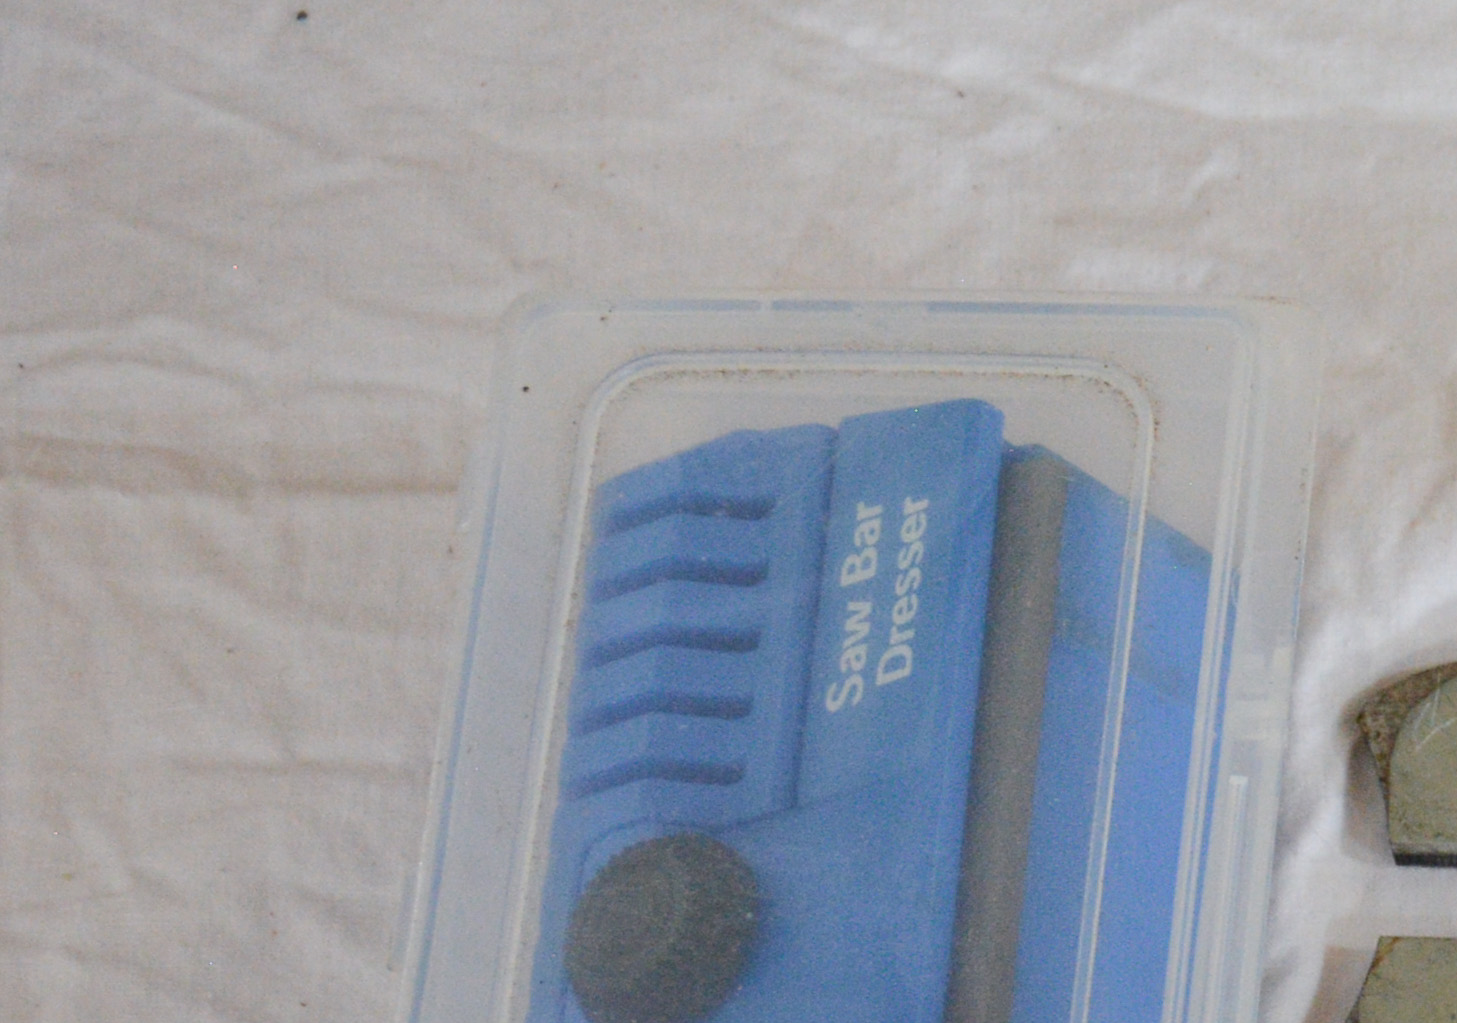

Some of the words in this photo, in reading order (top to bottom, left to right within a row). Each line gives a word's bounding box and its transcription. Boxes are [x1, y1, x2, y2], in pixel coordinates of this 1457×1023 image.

[840, 501, 882, 587] Bar
[876, 497, 929, 686] Dresser
[826, 601, 872, 713] Saw
